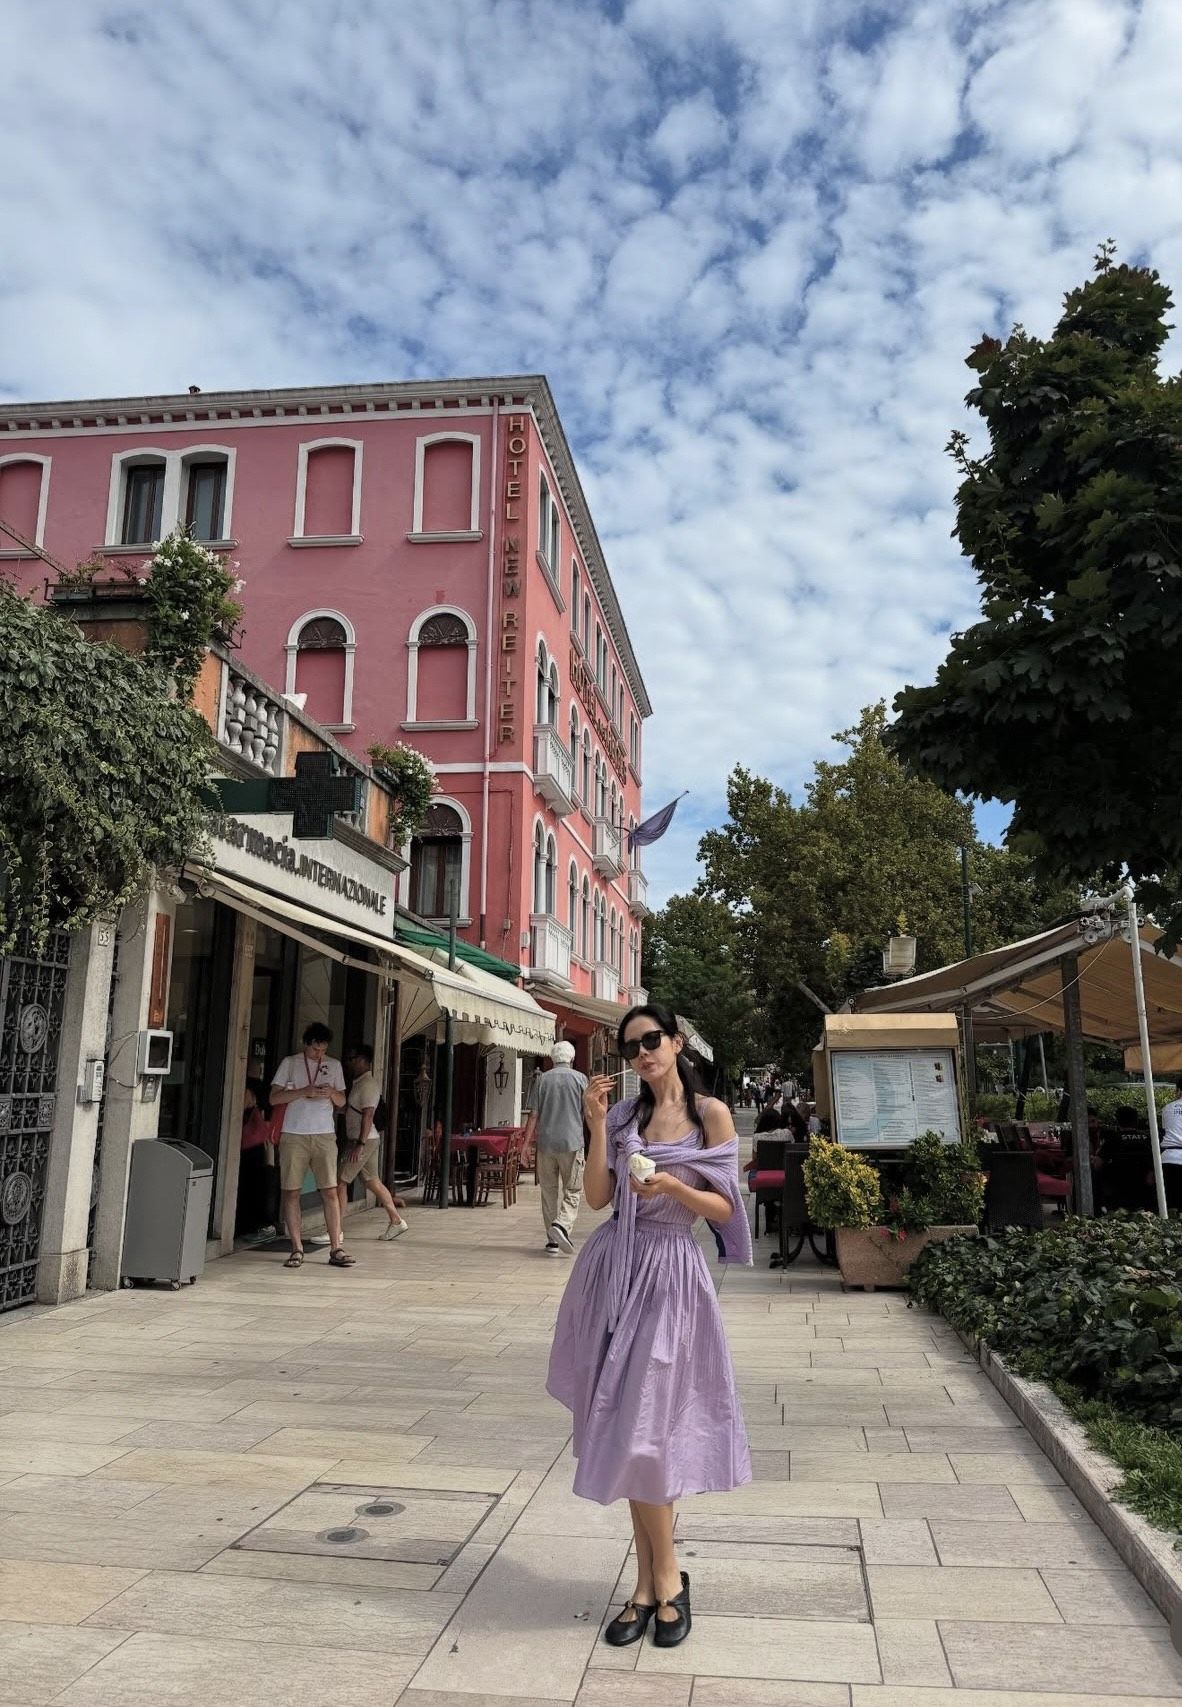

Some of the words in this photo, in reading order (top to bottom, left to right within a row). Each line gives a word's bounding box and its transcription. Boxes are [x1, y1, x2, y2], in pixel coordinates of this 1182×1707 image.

[506, 416, 526, 520] HOTEL
[503, 536, 521, 598] NEW
[500, 612, 519, 745] REITER
[299, 854, 387, 916] INTERNAZIONALE
